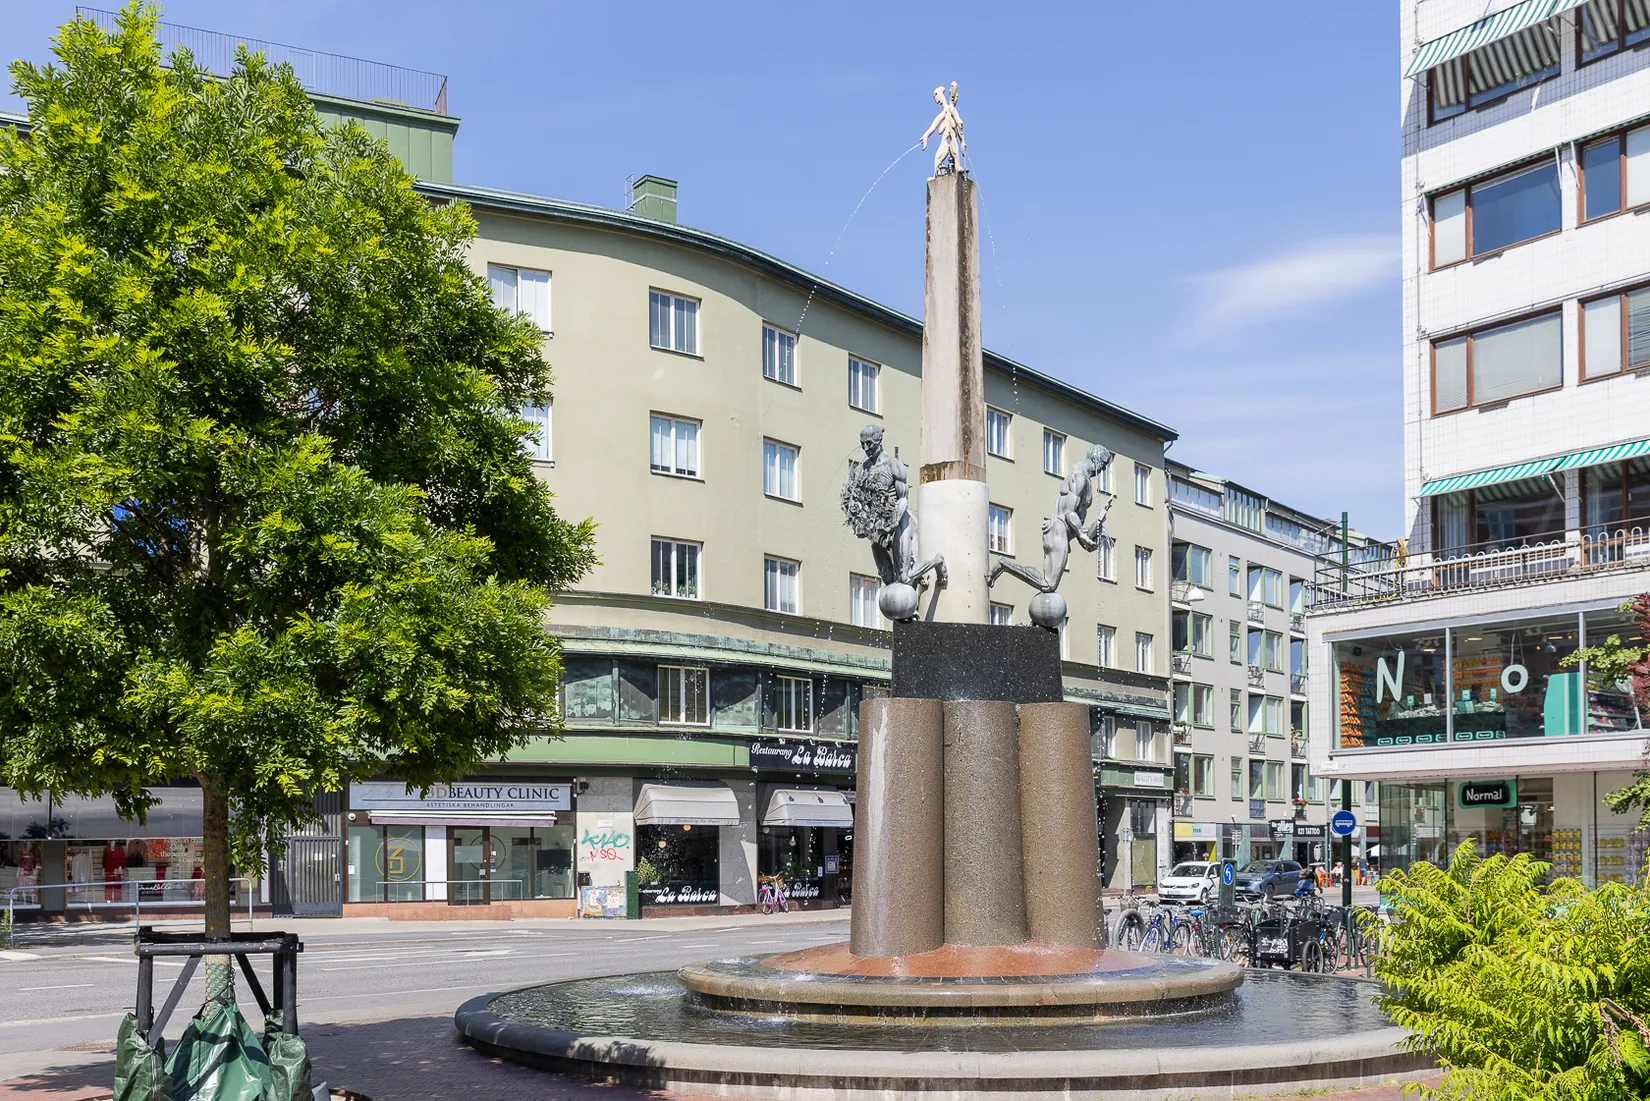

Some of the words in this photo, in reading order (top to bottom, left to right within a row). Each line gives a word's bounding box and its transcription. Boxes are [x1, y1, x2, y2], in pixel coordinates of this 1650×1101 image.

[751, 743, 792, 760] Restaurang
[792, 745, 812, 765] La
[813, 745, 852, 768] Barca
[507, 787, 559, 799] CLINIC
[1466, 788, 1502, 801] Normal
[1277, 820, 1294, 833] alley
[655, 886, 676, 903] La
[677, 885, 717, 902] Barca
